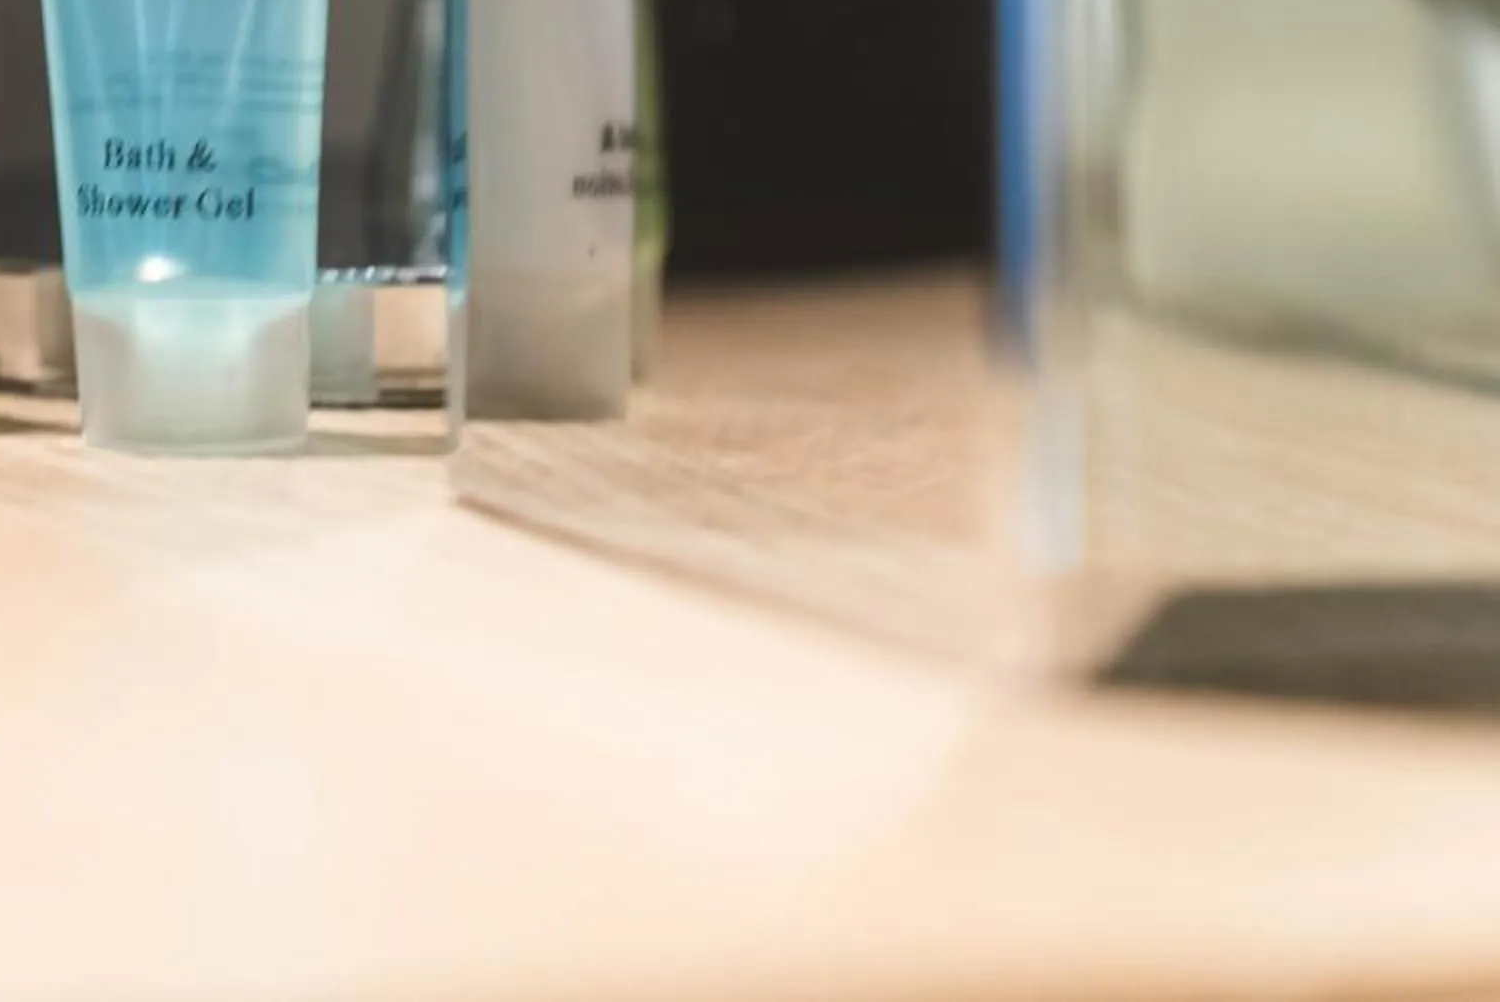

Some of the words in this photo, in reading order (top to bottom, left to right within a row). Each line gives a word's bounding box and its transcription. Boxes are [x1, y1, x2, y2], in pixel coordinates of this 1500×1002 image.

[103, 136, 176, 173] Bath
[186, 139, 218, 174] &
[76, 183, 186, 221] Shower
[196, 186, 257, 222] Gel
